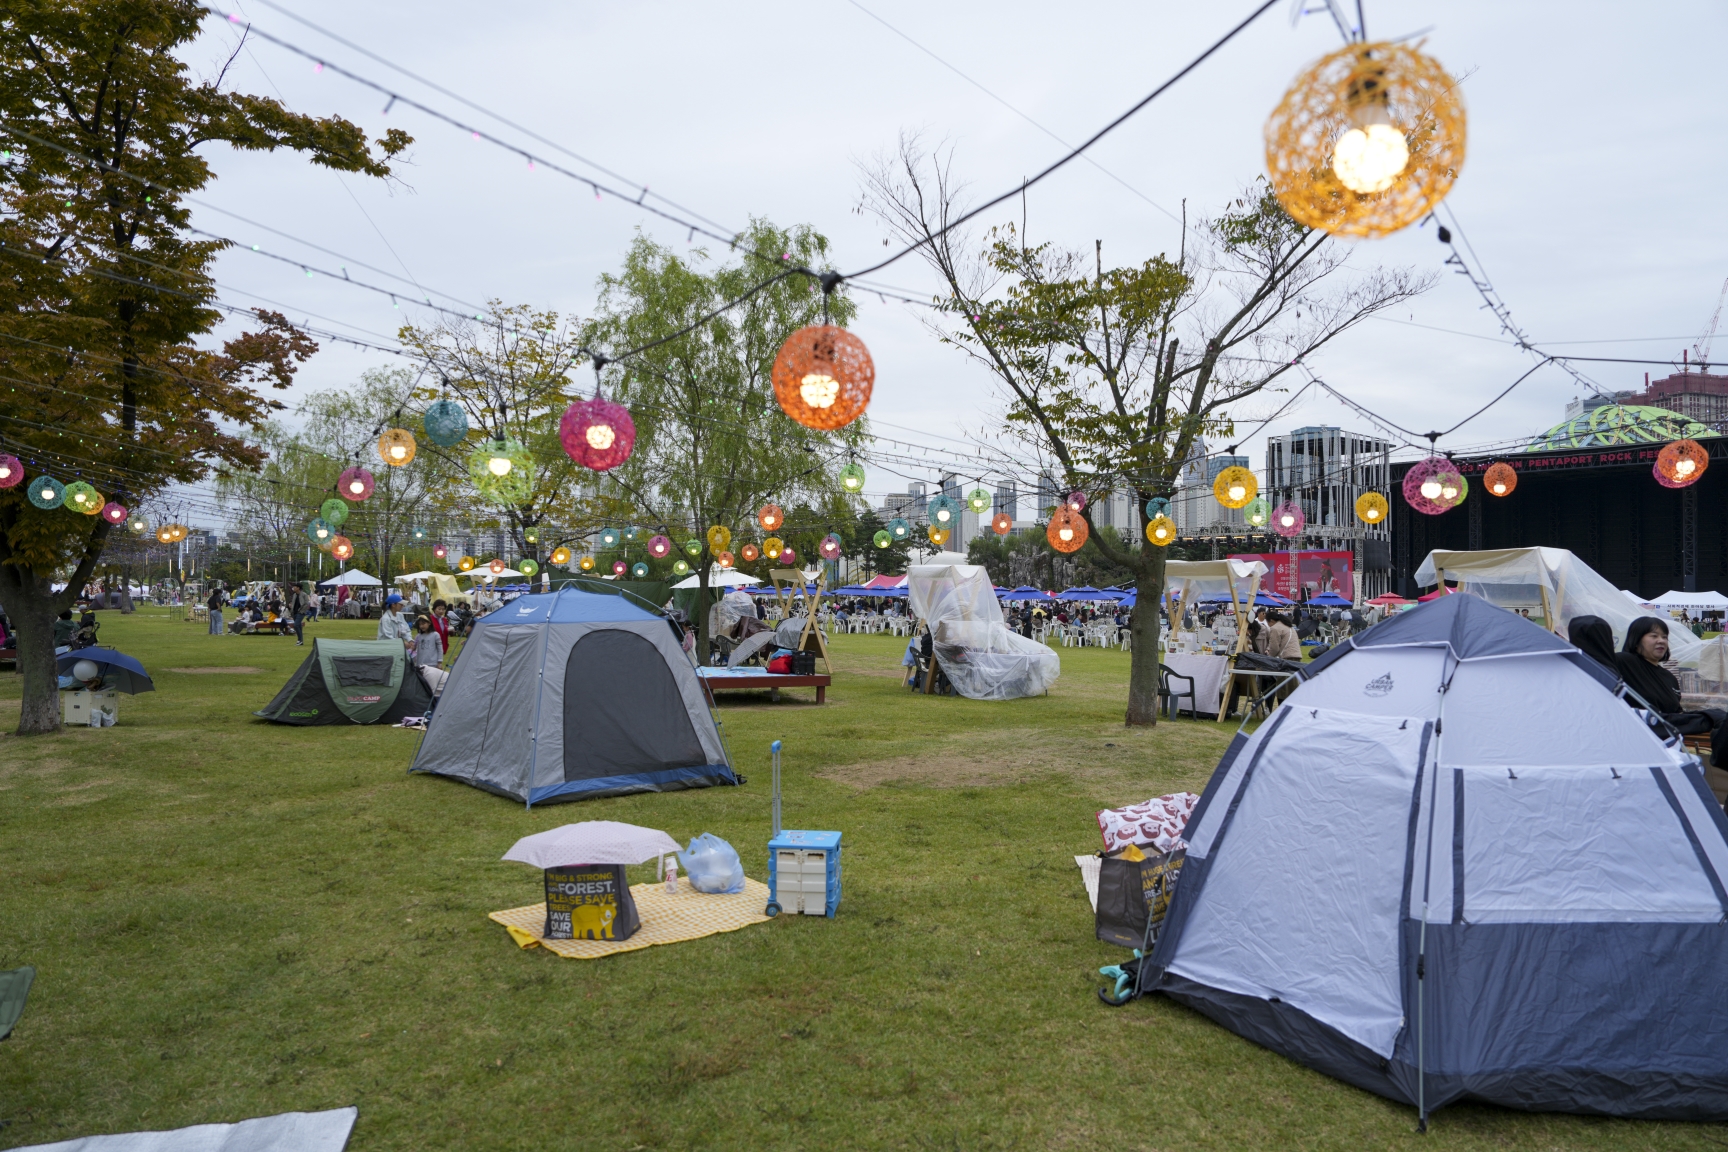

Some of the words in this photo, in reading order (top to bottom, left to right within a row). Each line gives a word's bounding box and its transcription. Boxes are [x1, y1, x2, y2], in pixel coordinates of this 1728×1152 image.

[1528, 455, 1593, 468] PENTAPORT
[1600, 452, 1633, 462] ROCK
[1639, 450, 1661, 459] FES
[555, 874, 567, 882] BIG
[569, 874, 575, 882] &
[576, 872, 615, 882] STRONG.
[558, 881, 616, 895] FOREST.
[585, 893, 616, 904] SAVE
[550, 911, 571, 921] SAVE
[551, 921, 571, 932] OUR
